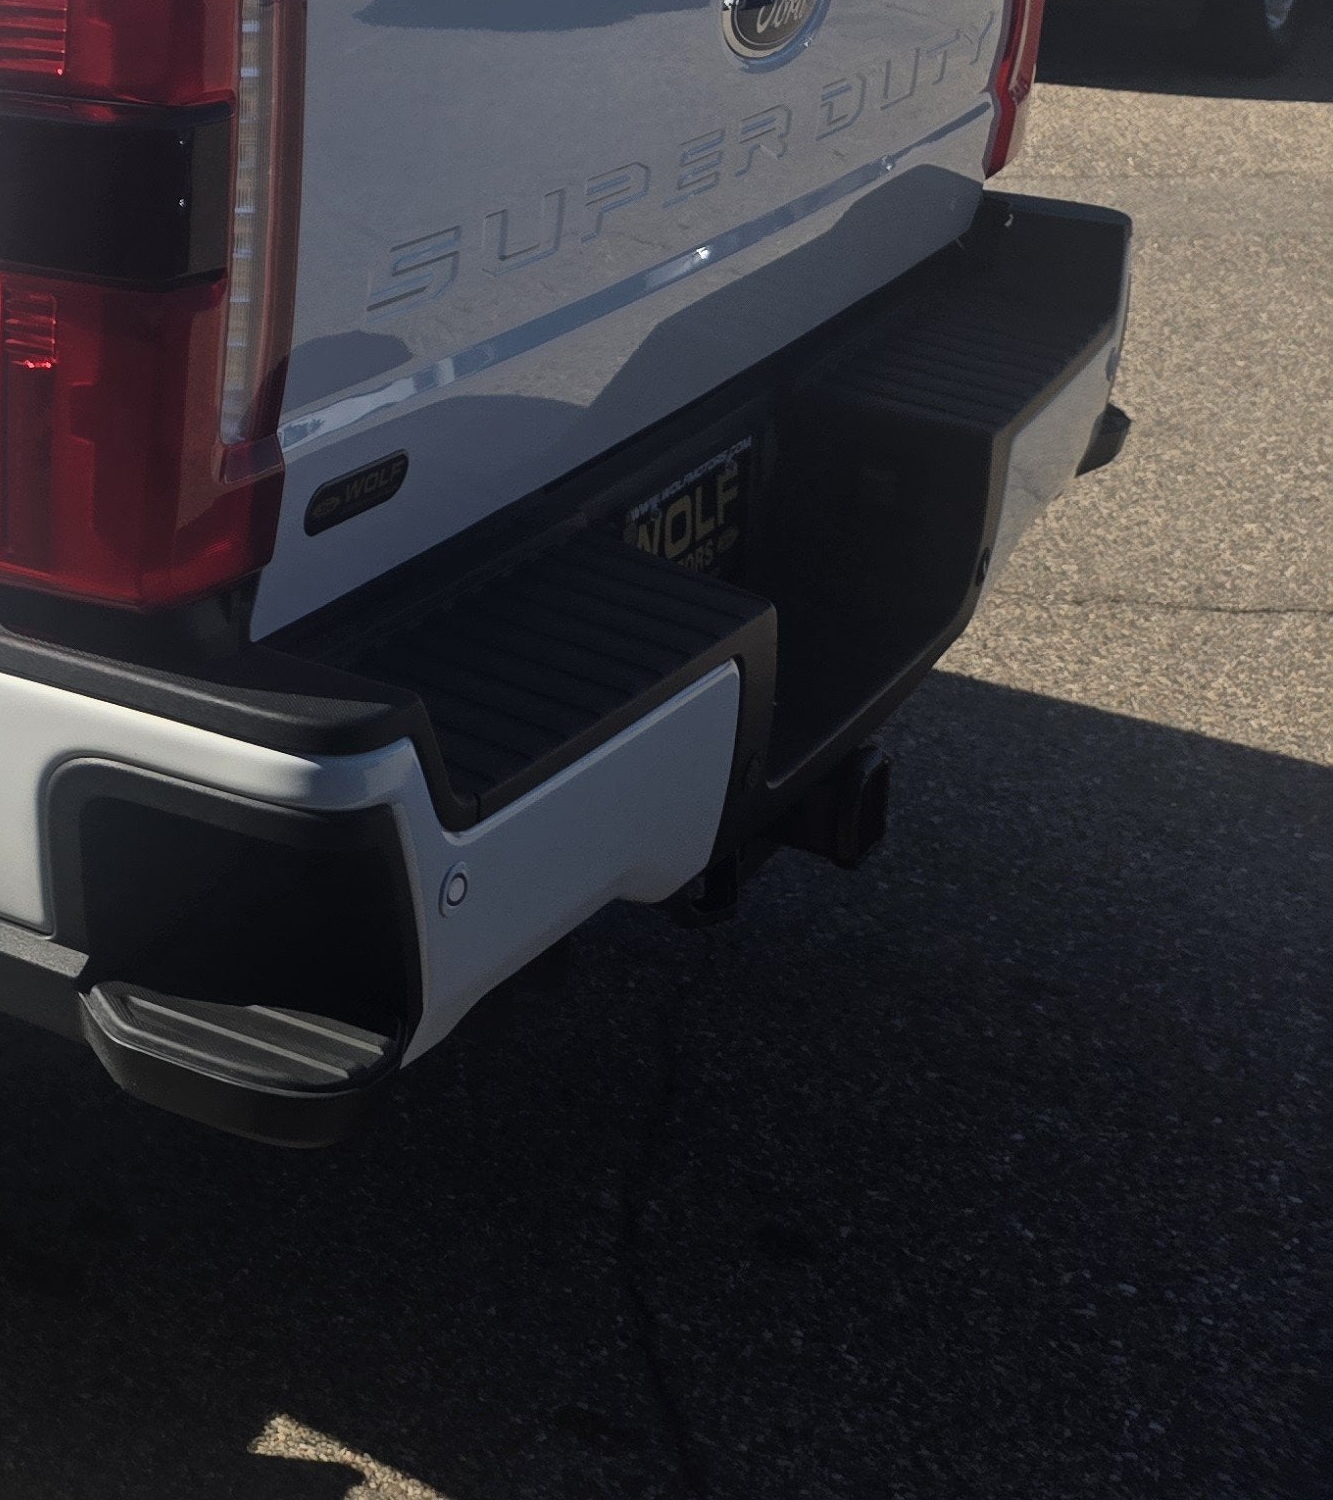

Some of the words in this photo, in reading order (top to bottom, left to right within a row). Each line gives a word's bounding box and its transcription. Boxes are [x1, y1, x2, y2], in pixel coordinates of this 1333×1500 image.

[366, 103, 793, 324] SUPER
[815, 9, 997, 142] DUTY
[345, 459, 406, 502] WOLF
